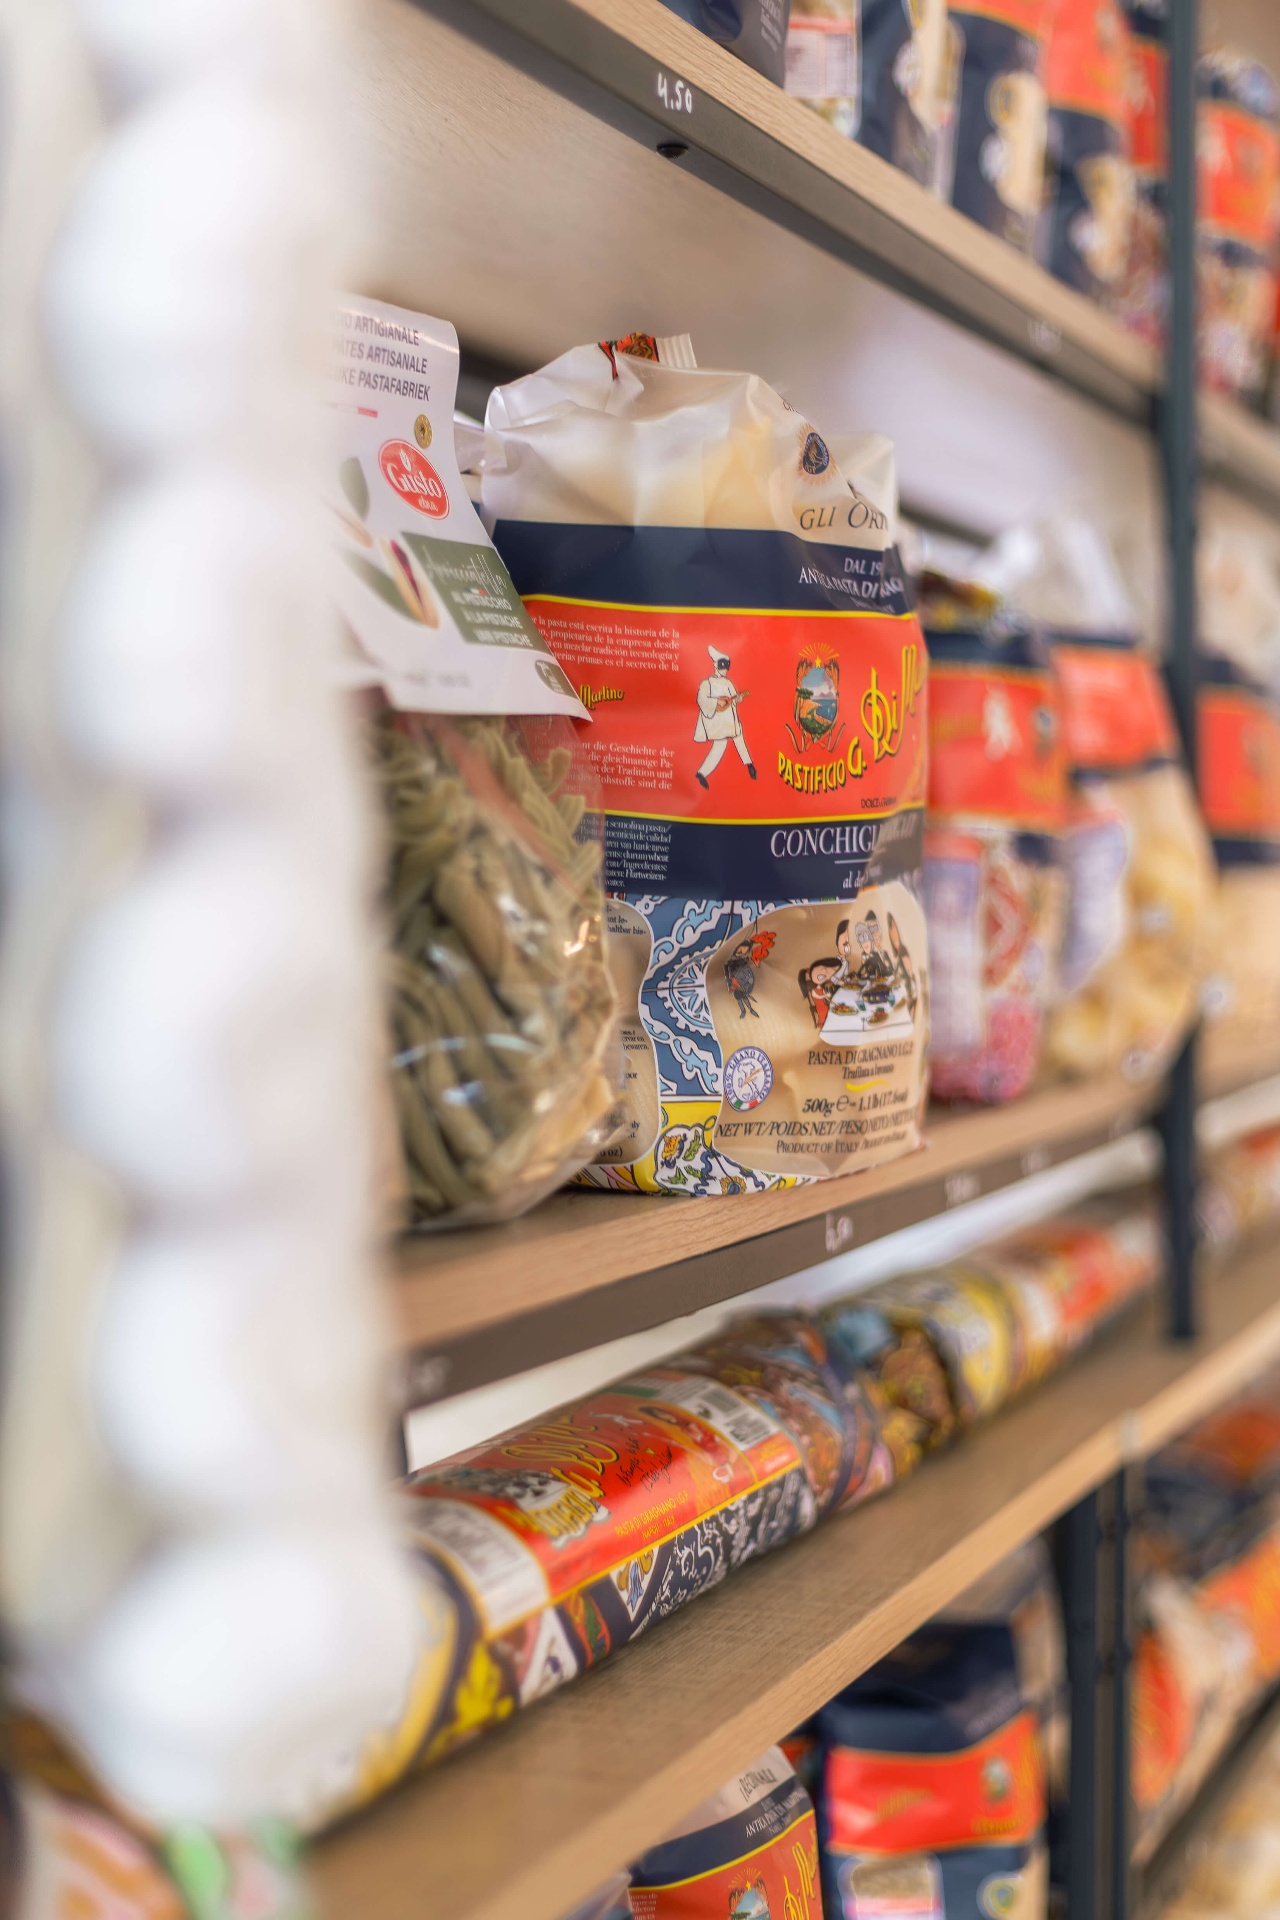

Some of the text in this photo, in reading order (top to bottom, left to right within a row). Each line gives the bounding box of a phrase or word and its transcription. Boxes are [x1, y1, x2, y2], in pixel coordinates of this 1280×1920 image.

[657, 72, 692, 114] 4.50
[355, 315, 419, 346] ARTIGIANALE
[366, 345, 427, 375] ARTISANALE
[358, 370, 431, 402] PASTAFABRIEK
[387, 463, 442, 499] Gusto
[800, 506, 837, 531] GLI
[844, 557, 867, 574] DAL
[548, 619, 568, 629] pasta
[569, 621, 584, 630] está
[586, 623, 613, 634] escrita
[615, 624, 622, 635] la
[624, 626, 657, 637] historia
[658, 628, 670, 639] de
[672, 629, 680, 639] la
[550, 631, 593, 644] propietaria
[594, 633, 605, 643] de
[606, 634, 614, 645] la
[616, 638, 652, 650] empresa
[653, 638, 680, 649] desde
[577, 655, 604, 665] primas
[605, 658, 614, 667] es
[625, 661, 658, 670] secreto
[658, 661, 670, 671] de
[671, 661, 680, 672] la
[778, 751, 847, 794] PASTIFICIO
[847, 735, 868, 777] G.
[860, 666, 898, 762] Di
[593, 741, 675, 758] die Geschichte der
[602, 753, 659, 769] gleichnamige
[601, 764, 615, 773] der
[616, 765, 655, 778] Tradition
[656, 770, 673, 779] und
[637, 779, 657, 789] sind
[658, 780, 672, 790] die
[807, 1050, 843, 1066] PASTA
[845, 1050, 857, 1065] DI
[715, 1122, 743, 1139] NET
[743, 1119, 811, 1137] WT/POIDS
[811, 1118, 868, 1136] NET/PESO
[776, 1139, 819, 1154] PRODUCT
[820, 1140, 832, 1153] OF
[615, 1520, 635, 1537] PASTA
